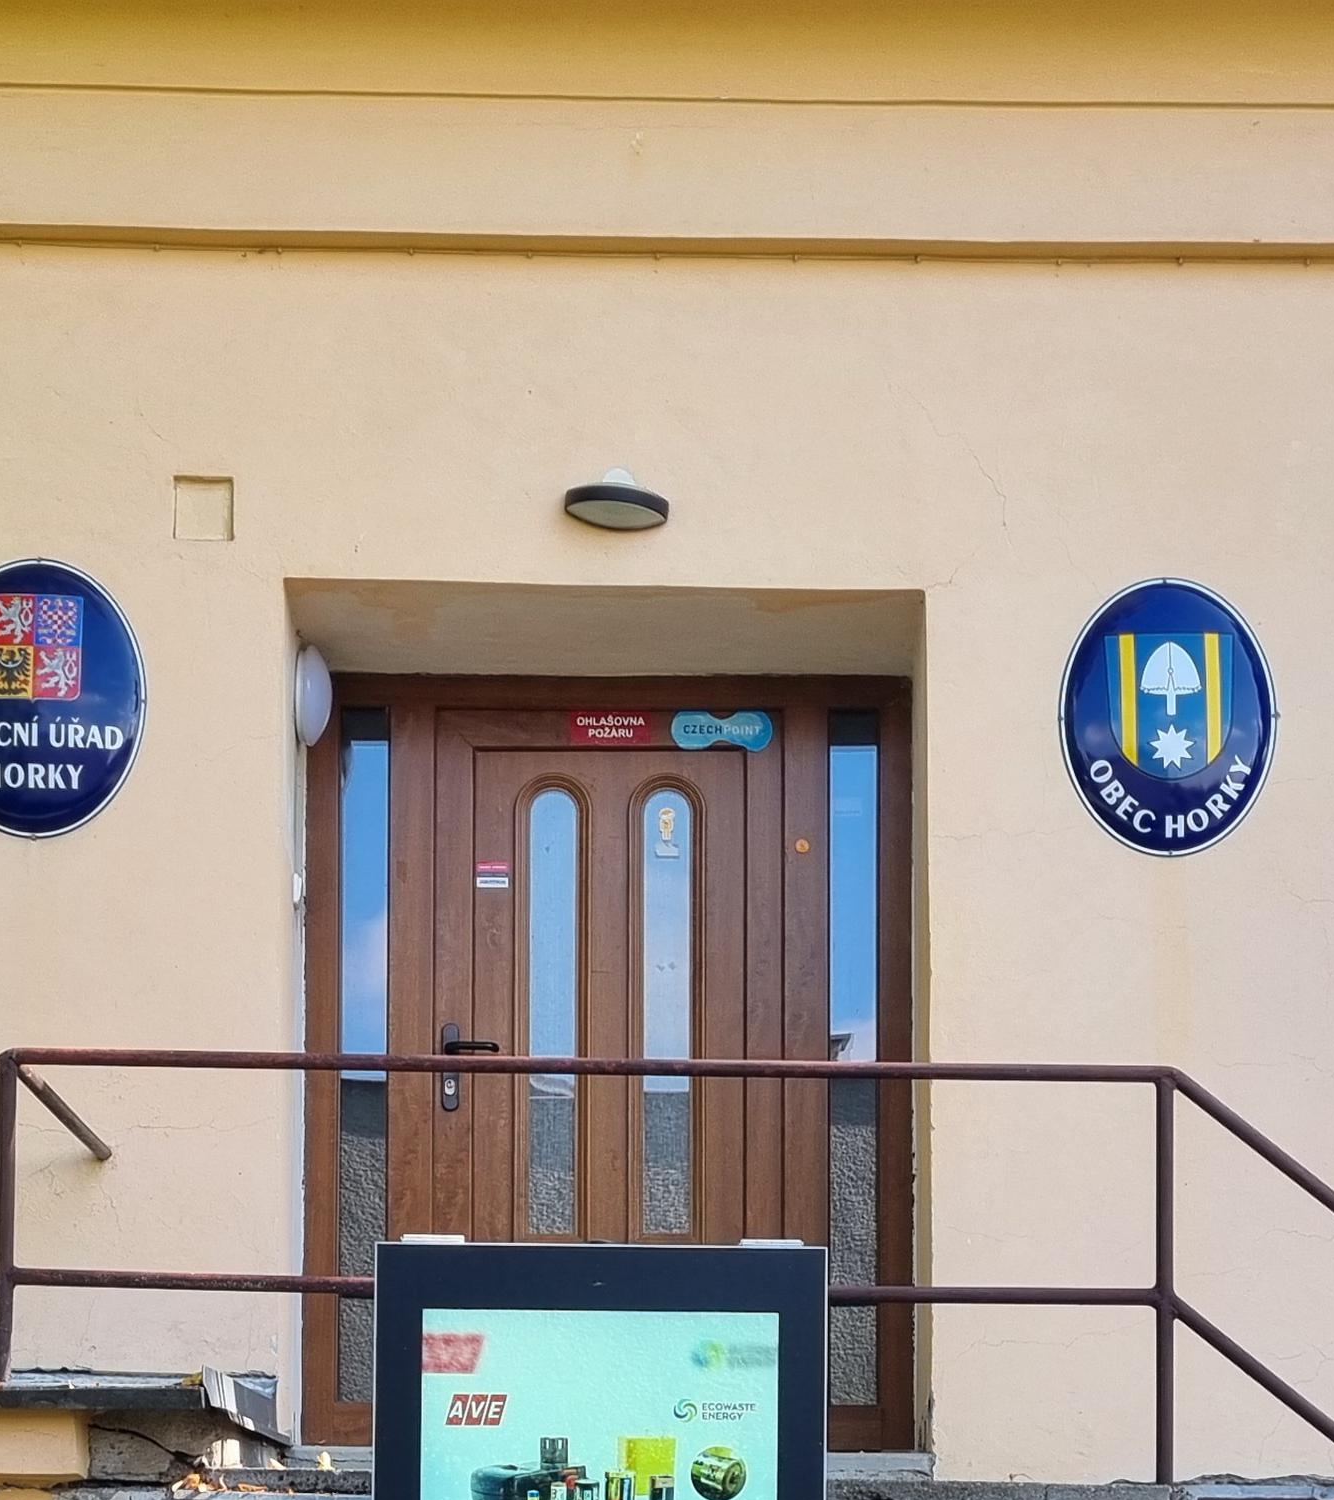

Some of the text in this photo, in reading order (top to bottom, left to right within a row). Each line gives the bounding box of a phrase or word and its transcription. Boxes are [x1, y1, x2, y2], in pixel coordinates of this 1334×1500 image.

[576, 713, 646, 727] OHLAŠOVNA
[48, 715, 124, 751] ÚŘAD
[587, 726, 634, 738] POŽÁRU
[1089, 754, 1253, 839] OBEC HORKY
[447, 1400, 504, 1419] AVE
[701, 1402, 756, 1411] ECOWASTE
[701, 1412, 743, 1421] ENERGY
